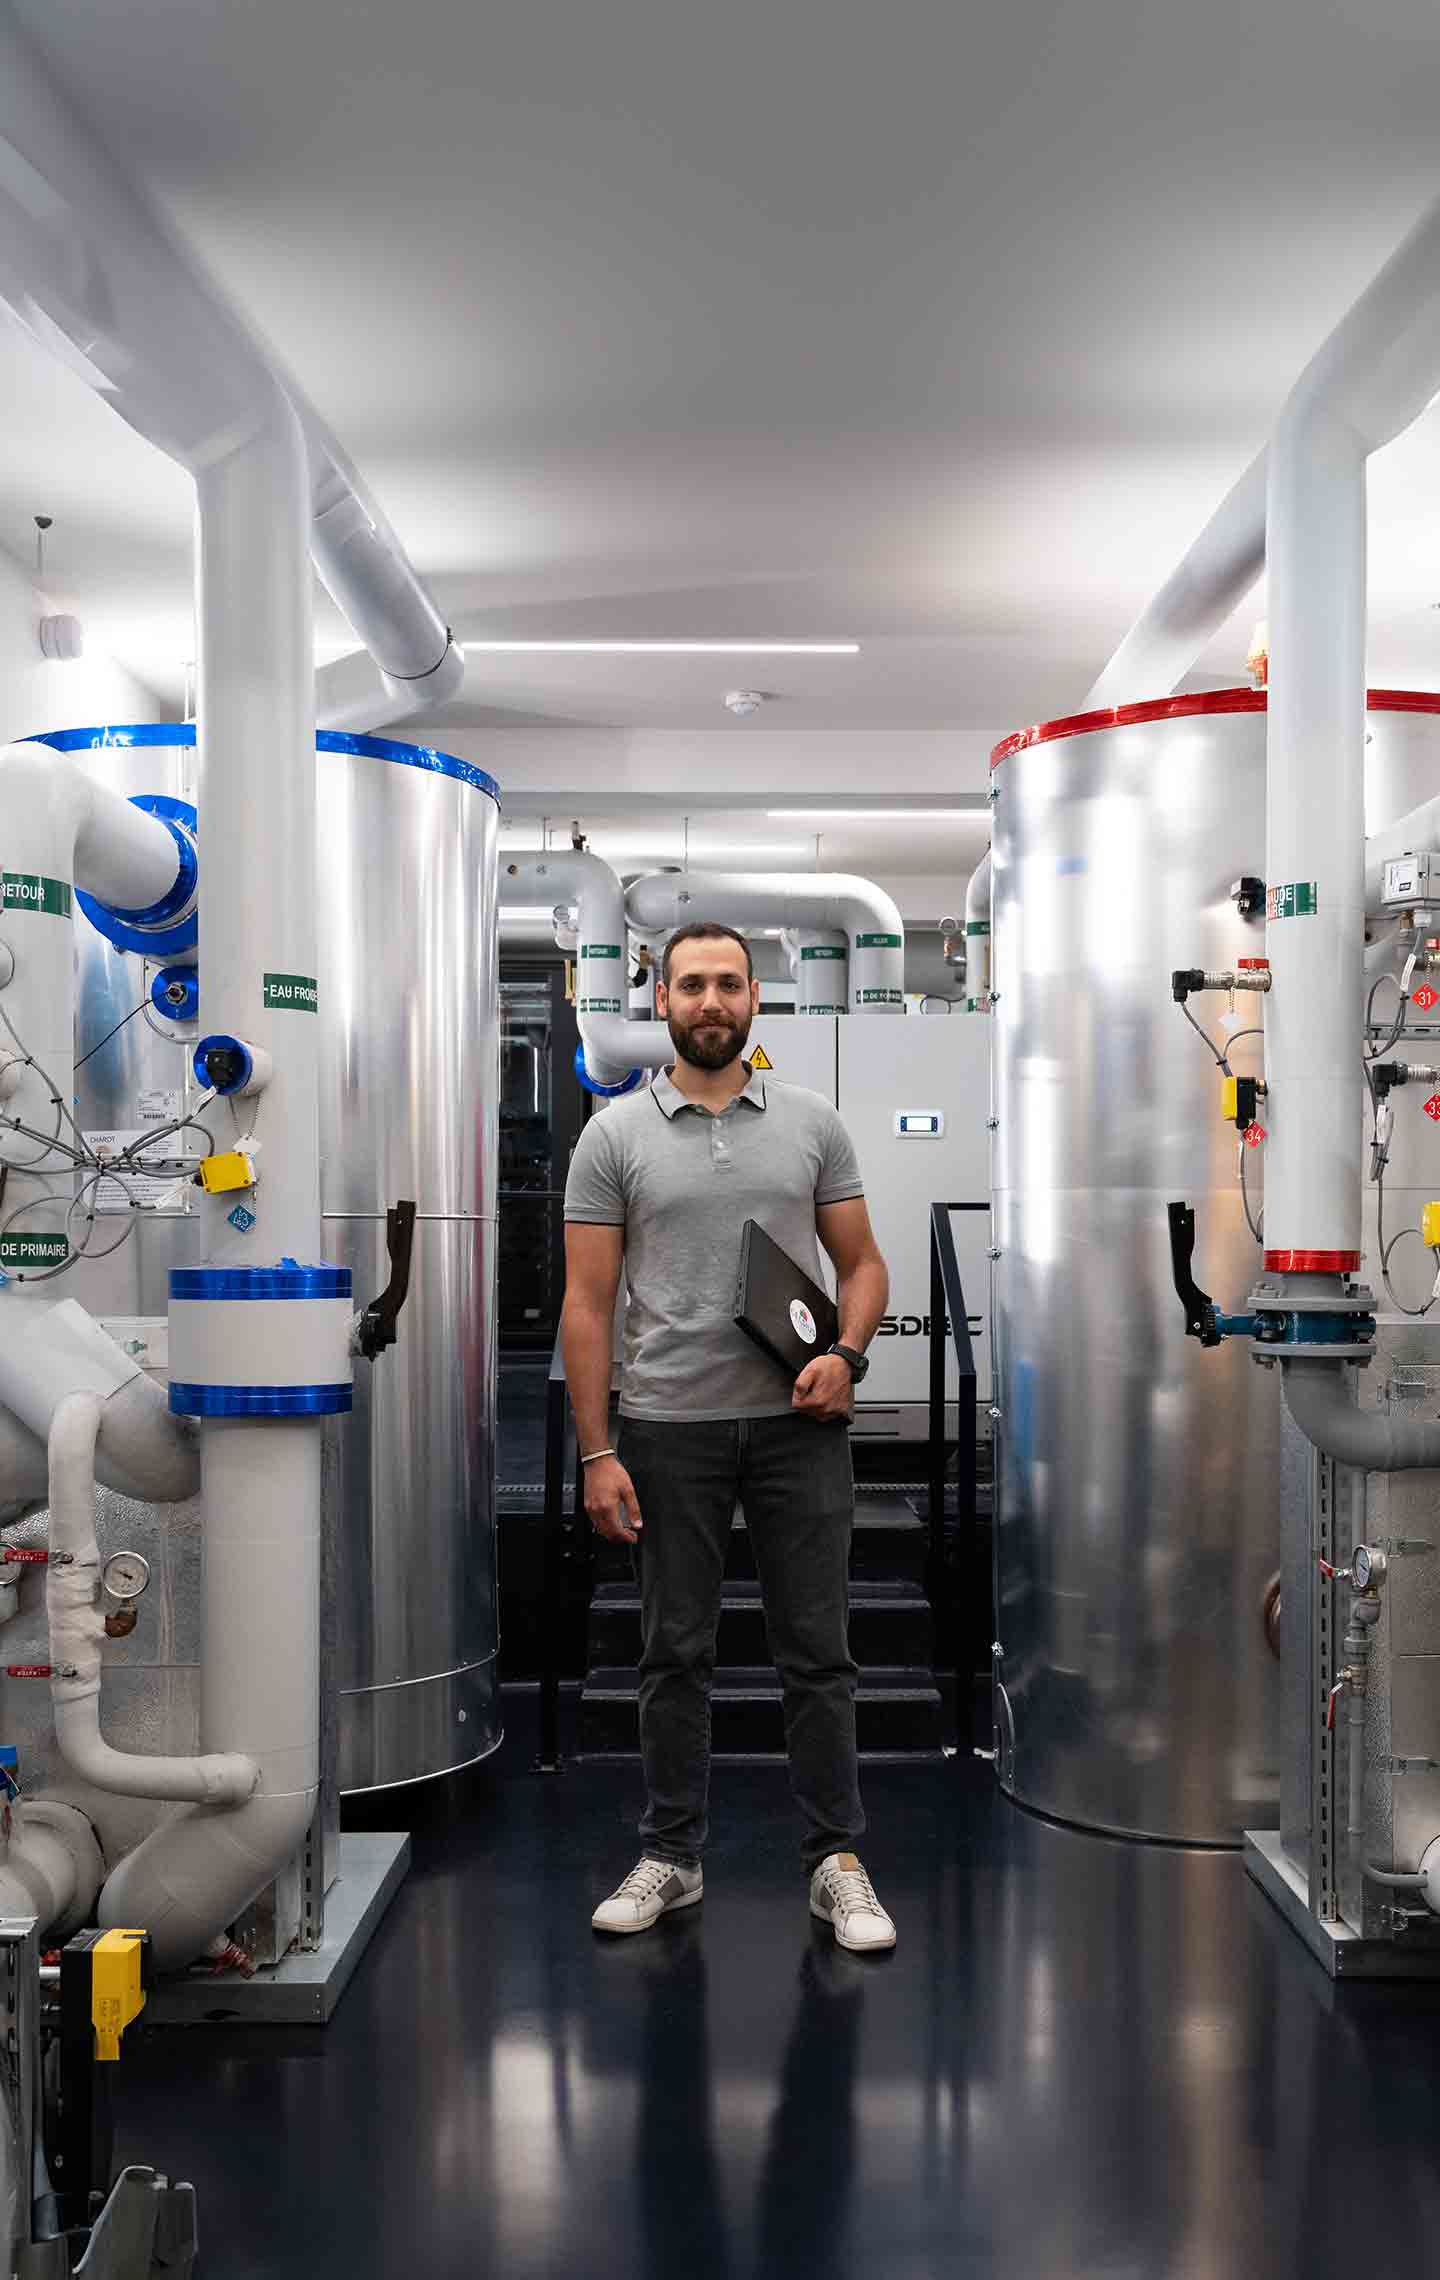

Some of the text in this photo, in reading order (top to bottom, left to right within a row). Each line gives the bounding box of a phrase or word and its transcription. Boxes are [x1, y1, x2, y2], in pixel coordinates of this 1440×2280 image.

[270, 984, 292, 998] EAU
[1418, 991, 1431, 1006] 31
[1247, 1128, 1261, 1142] 34
[1, 1242, 67, 1257] DE PRIMAIRE
